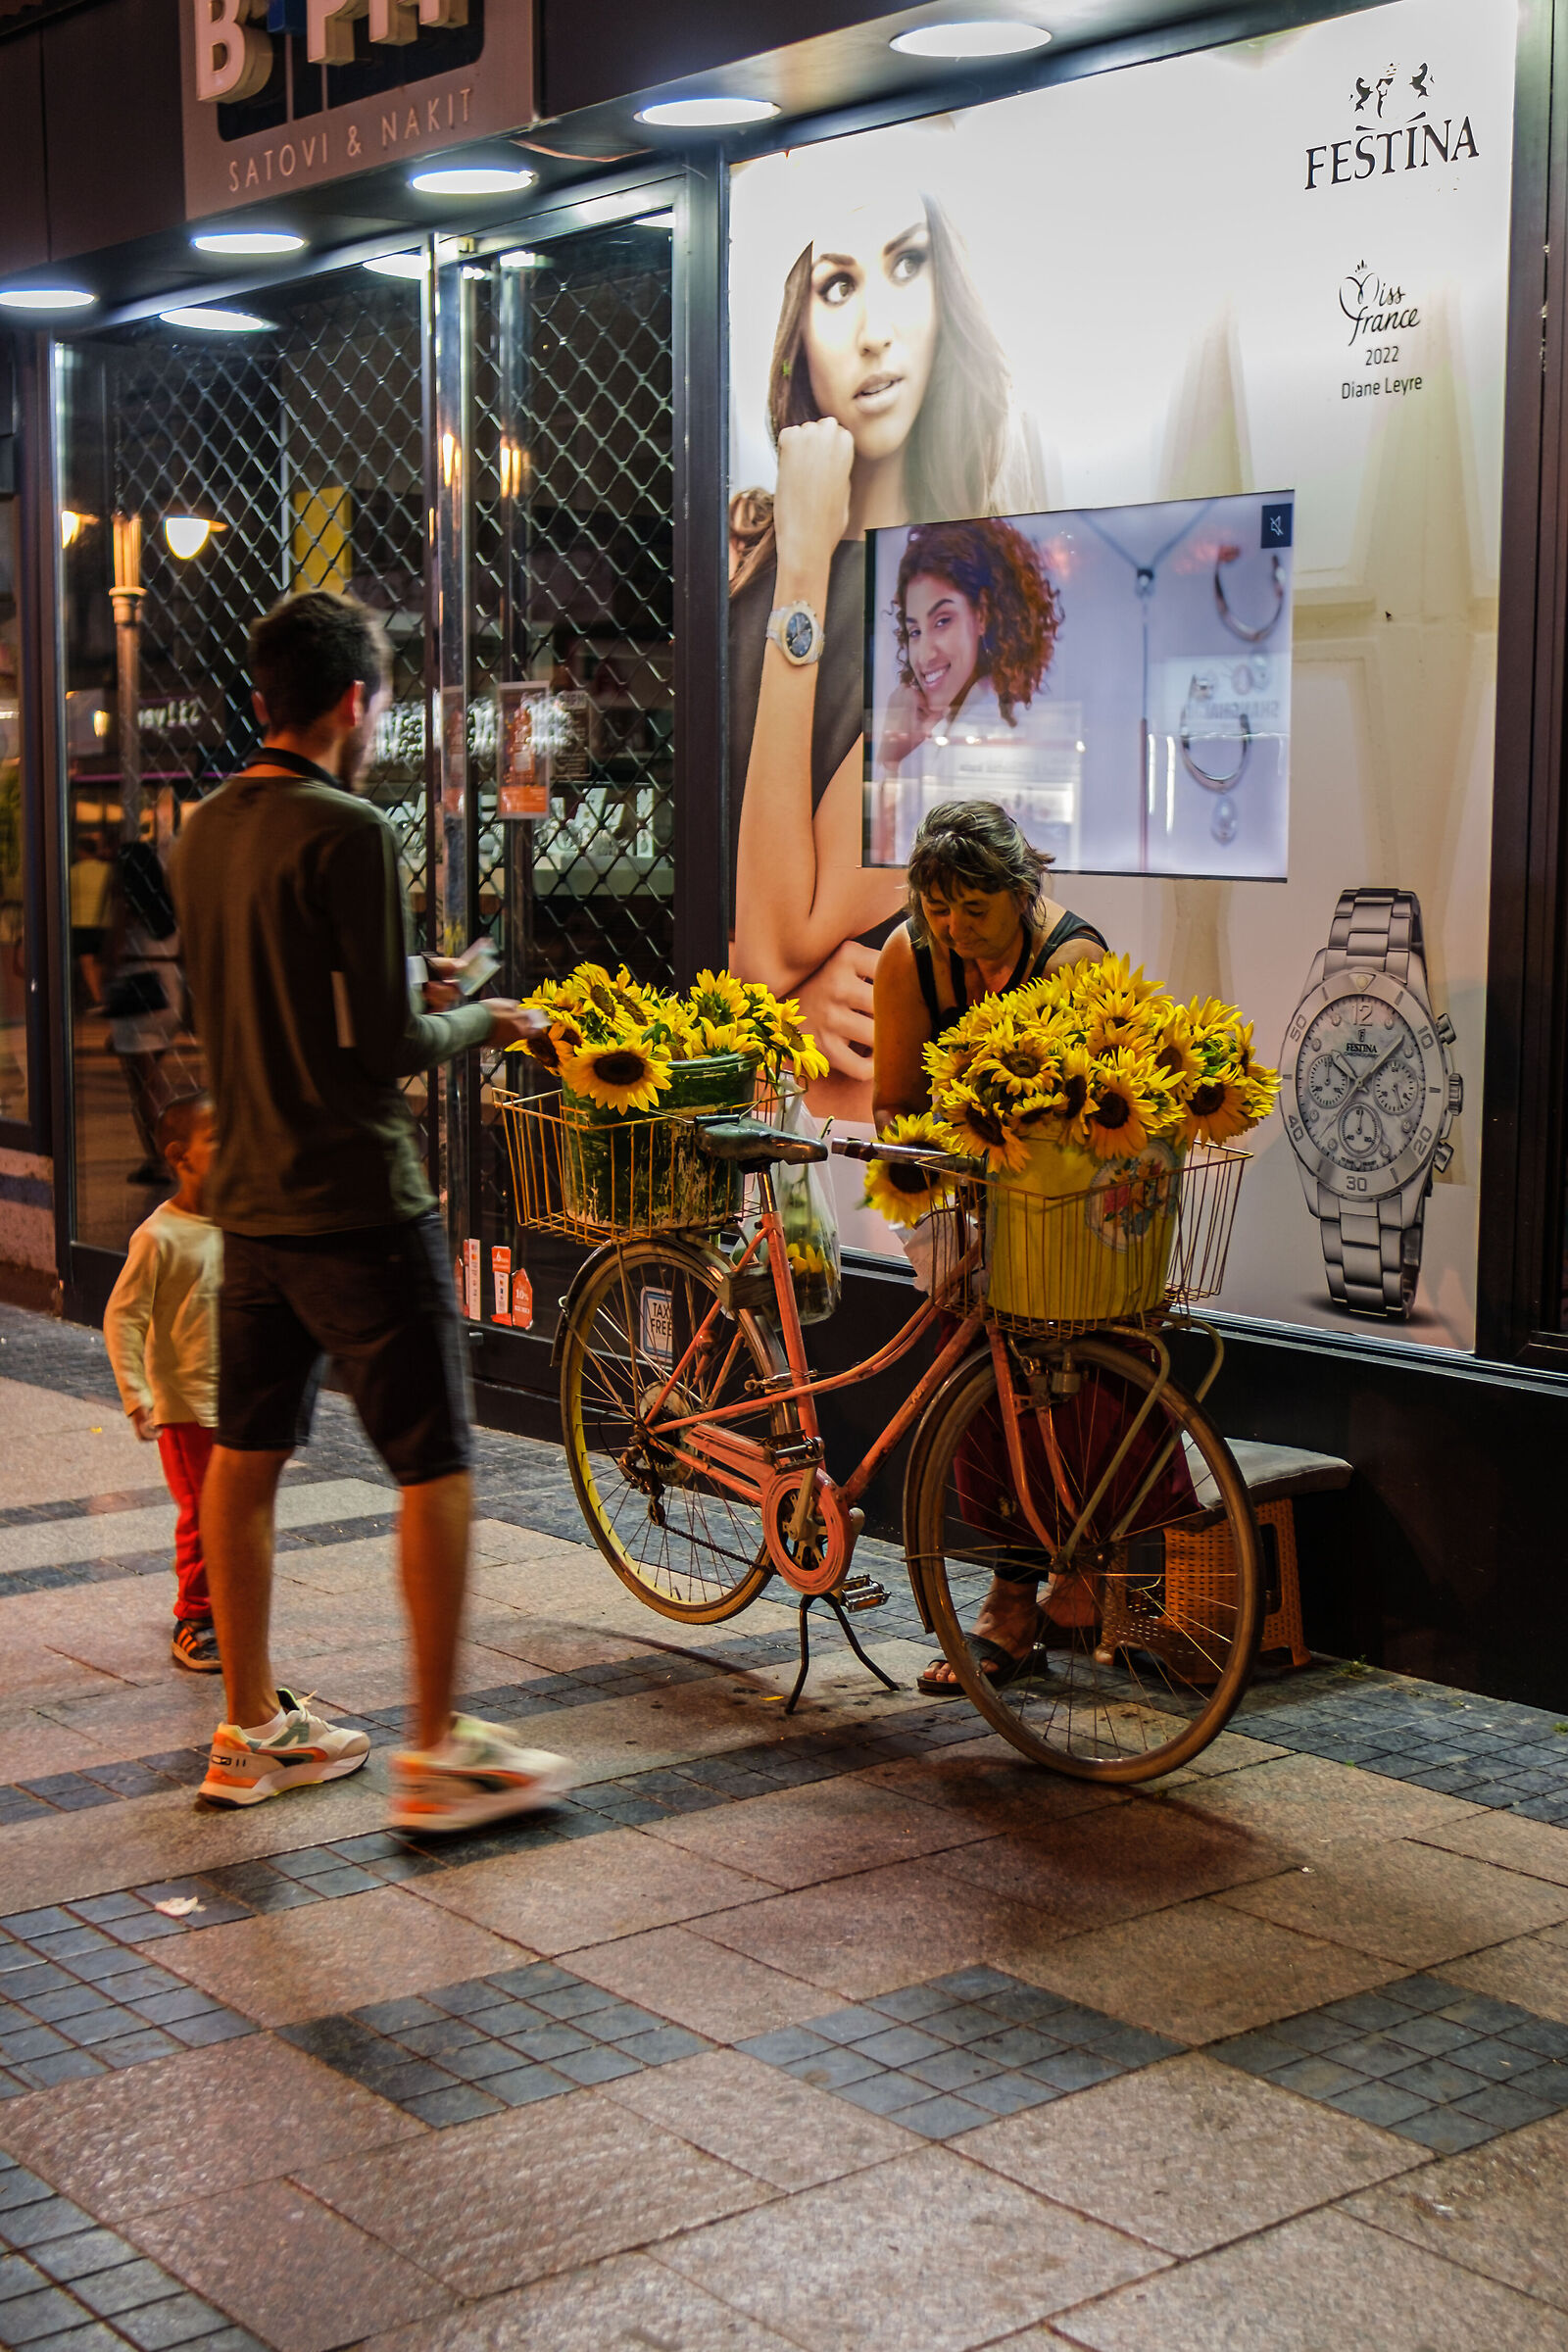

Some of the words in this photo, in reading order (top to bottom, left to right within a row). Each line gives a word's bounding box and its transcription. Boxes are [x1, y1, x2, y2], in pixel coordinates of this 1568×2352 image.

[228, 133, 328, 192] SATOVI
[347, 124, 362, 157] &
[381, 88, 472, 145] NAKIT
[1365, 346, 1399, 367] 2022
[1342, 381, 1381, 399] Diane
[1385, 376, 1423, 396] Leyre
[1351, 1002, 1373, 1026] 12
[1289, 1013, 1307, 1042] 50
[1417, 1025, 1435, 1051] 10
[1346, 1043, 1378, 1054] FESTINA
[1287, 1114, 1304, 1142] 40
[1413, 1125, 1433, 1157] 20
[1346, 1175, 1368, 1193] 30
[653, 1301, 670, 1320] TAX
